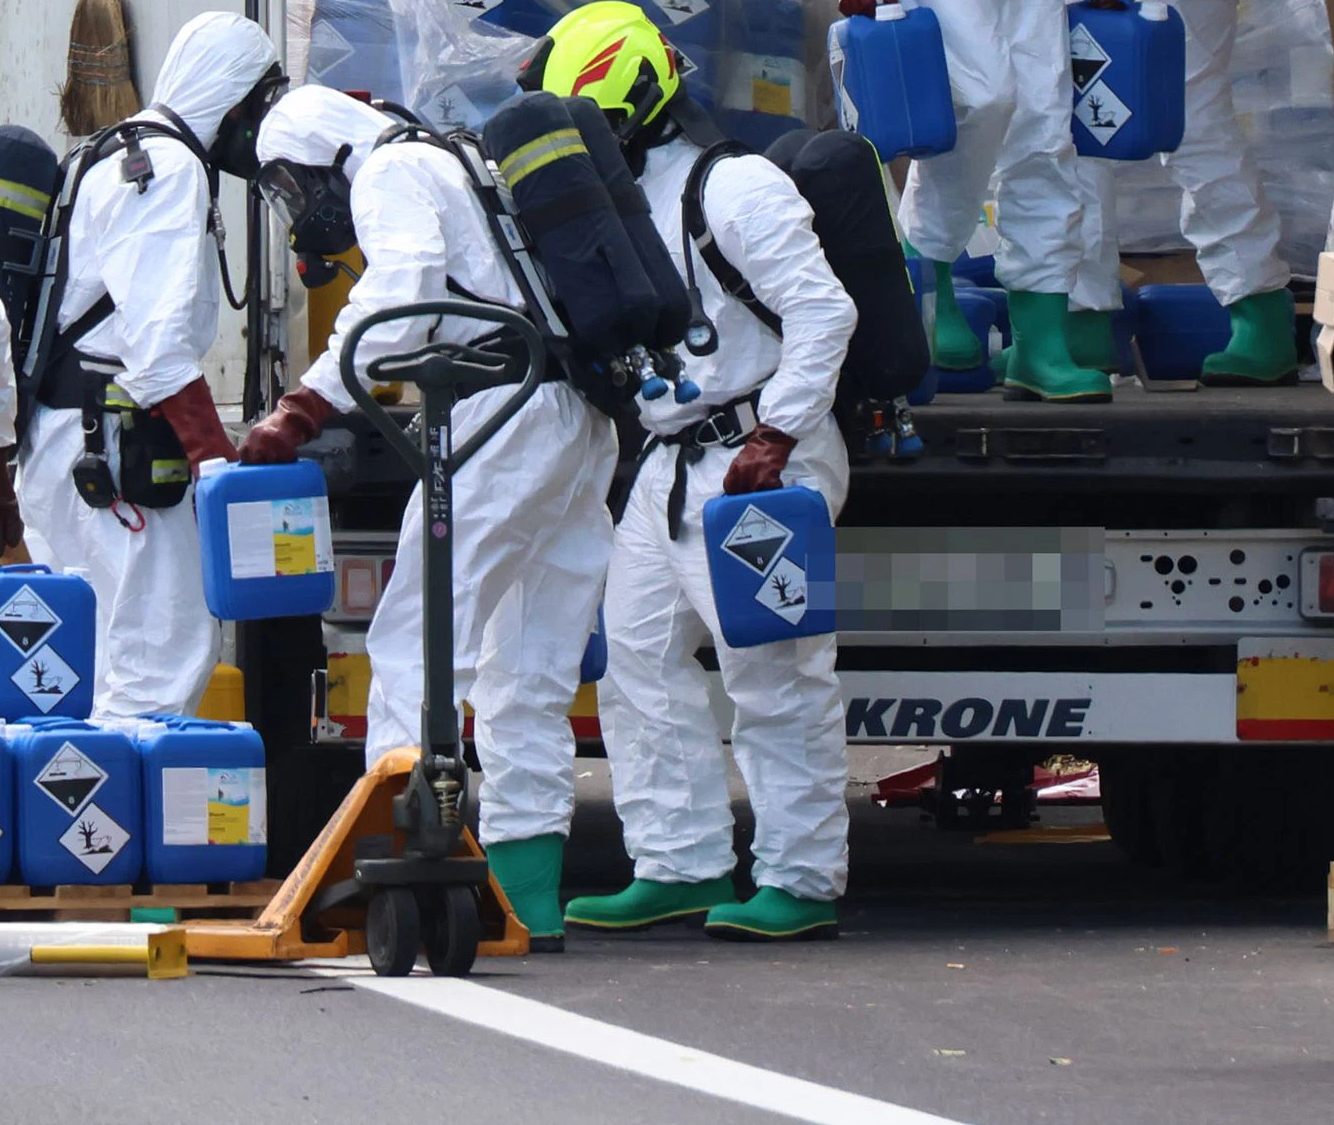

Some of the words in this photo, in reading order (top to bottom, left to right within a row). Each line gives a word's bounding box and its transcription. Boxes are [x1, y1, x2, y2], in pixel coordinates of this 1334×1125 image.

[756, 556, 764, 565] 8
[22, 636, 29, 646] 8
[845, 697, 1092, 739] KRONE
